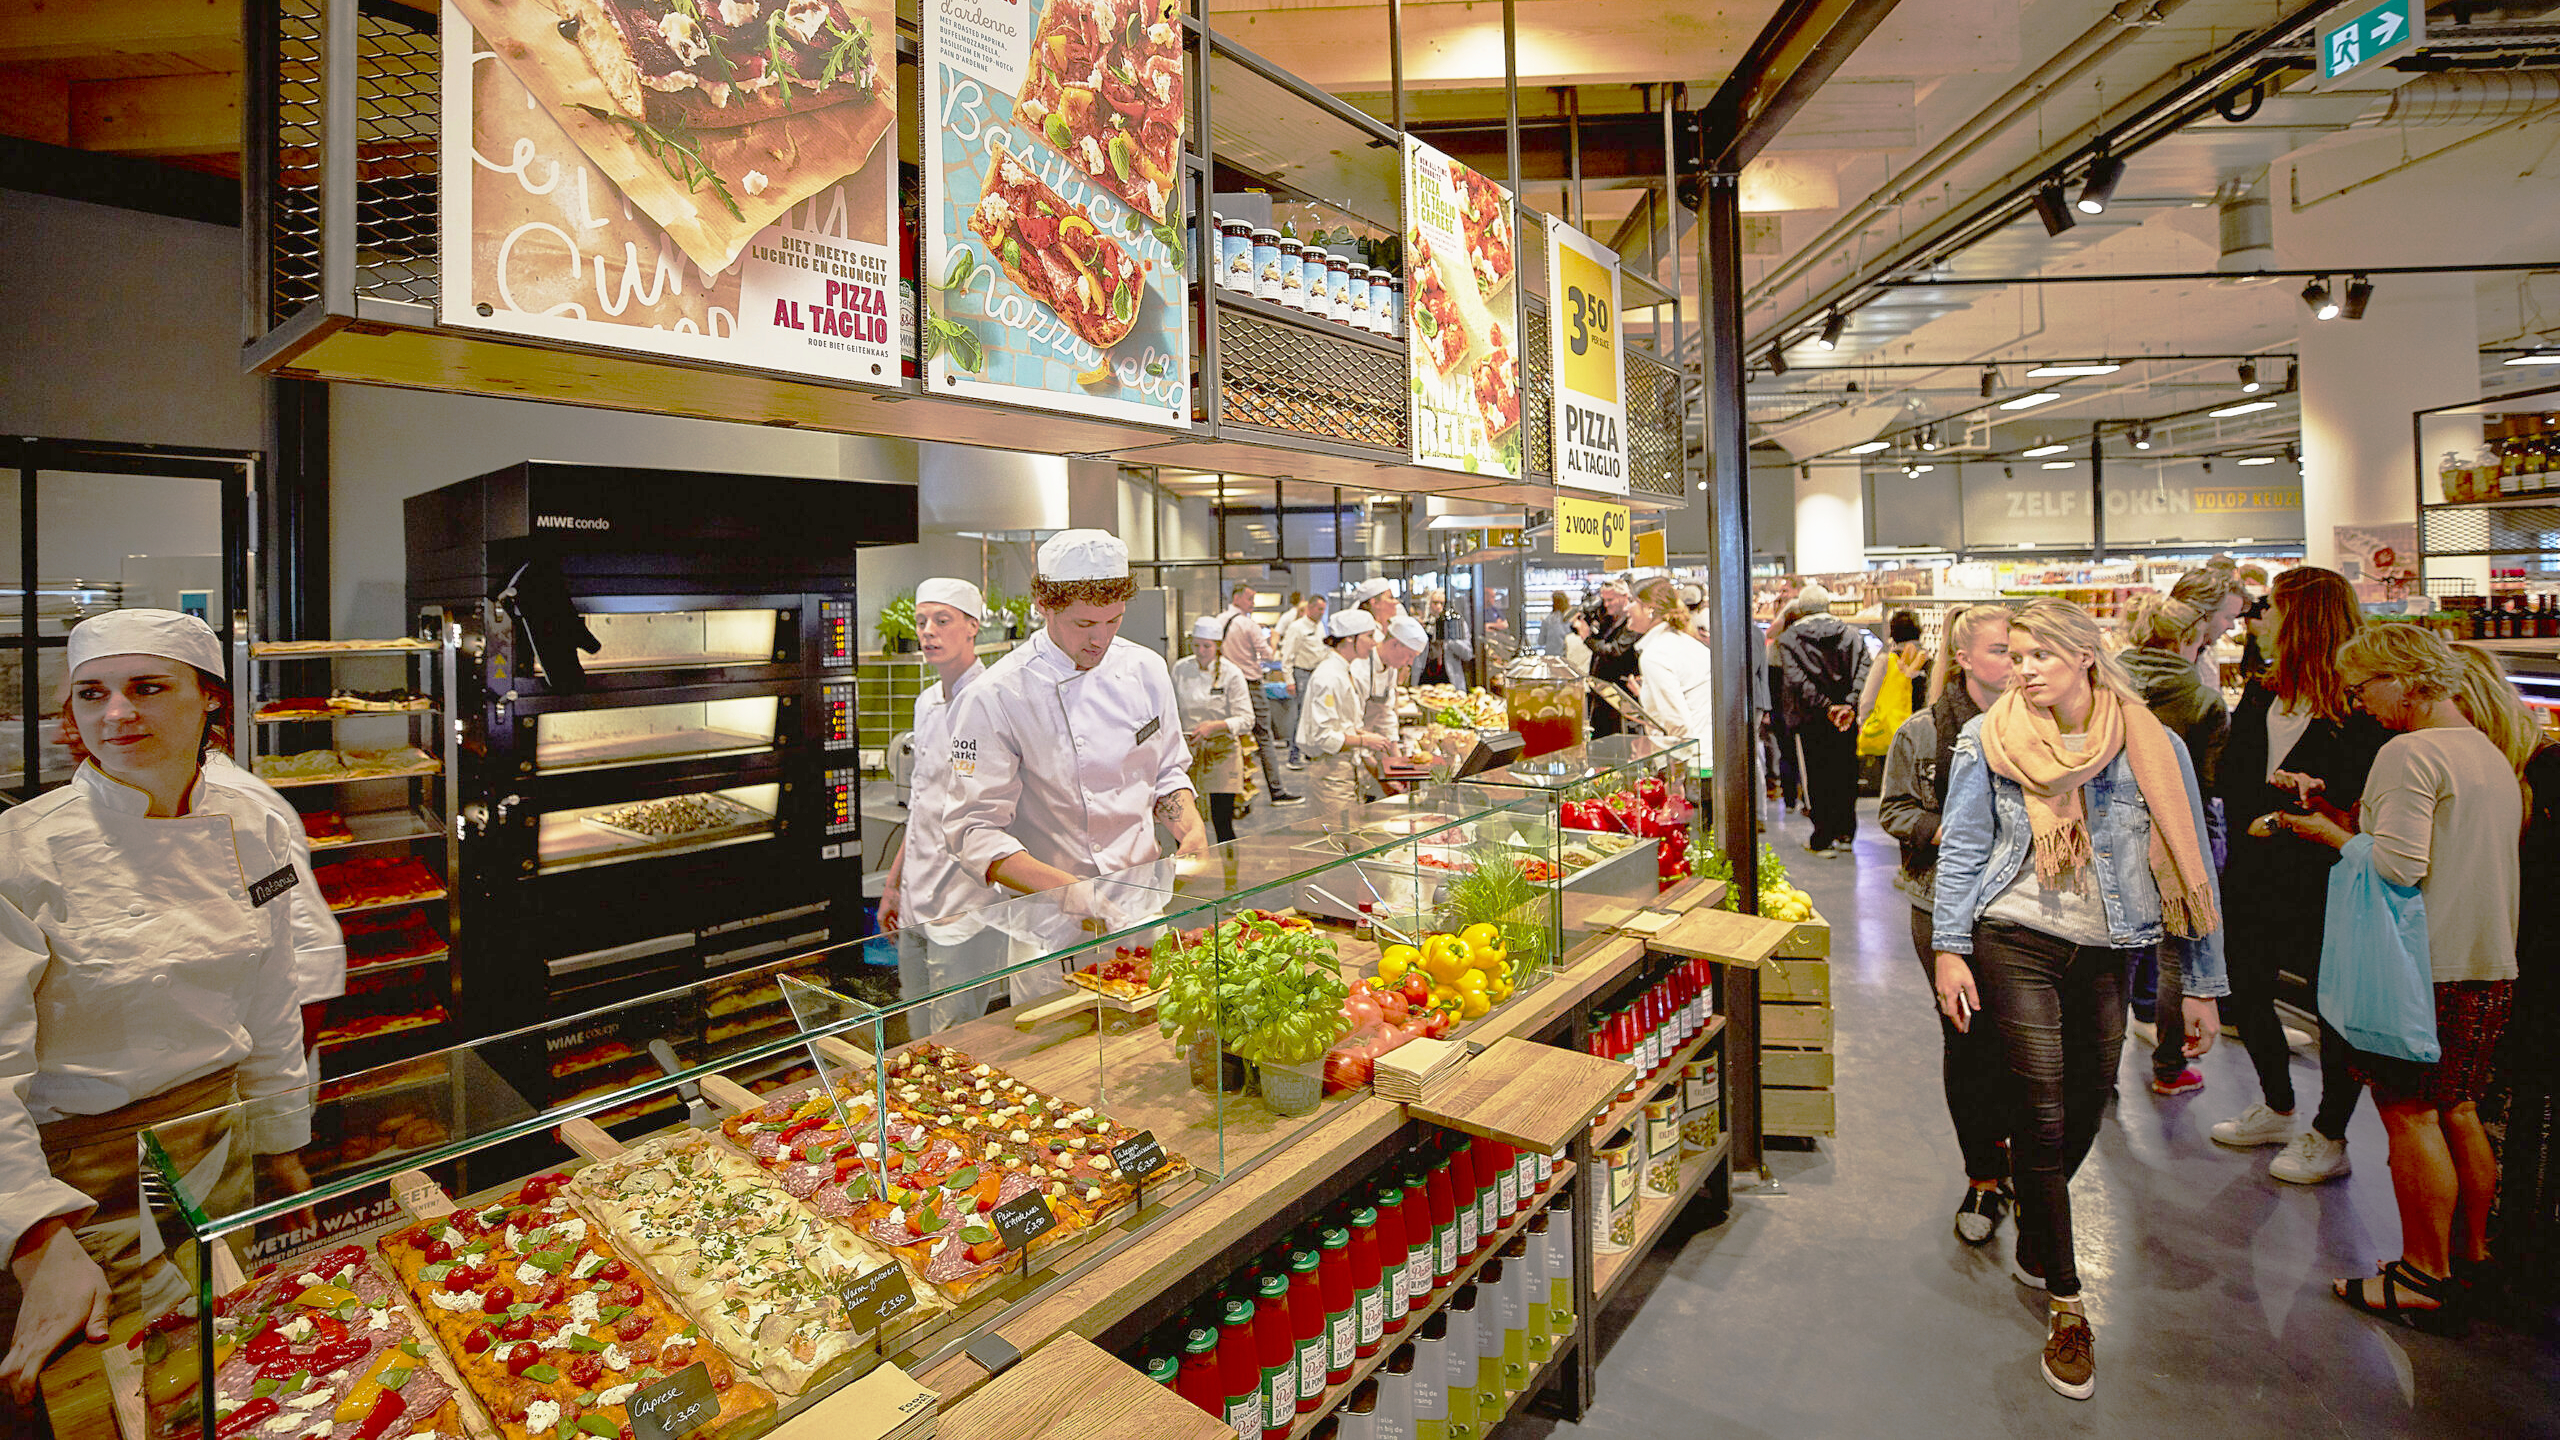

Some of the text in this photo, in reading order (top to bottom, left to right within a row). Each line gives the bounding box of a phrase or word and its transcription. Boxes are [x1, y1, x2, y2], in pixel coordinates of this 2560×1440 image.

[940, 15, 1008, 51] MET ROASTED PAPRIKA,
[940, 47, 955, 59] PAIN
[940, 36, 1014, 73] BASILICUM EN TOP-NOTCH
[1420, 173, 1441, 198] PIZZA
[1420, 190, 1456, 220] AL TAGLIO
[1421, 206, 1454, 235] CAPRESE
[752, 244, 887, 287] LUCHTIG EN CRUNCHY
[781, 235, 887, 273] BIET MEETS GEIT
[825, 278, 888, 318] PIZZA
[773, 298, 805, 331] AL
[808, 304, 888, 345] TAGLIO
[808, 337, 889, 359] RODE BIET GEITENKAAS
[1565, 403, 1620, 454] PIZZA
[1567, 447, 1621, 479] AL TAGLIO
[2006, 490, 2076, 518] ZELF
[2194, 491, 2247, 509] VOLOP
[536, 515, 610, 531] MIWE condo
[1565, 515, 1572, 533] 2
[1573, 516, 1599, 536] VOOR
[242, 1221, 318, 1260] WETEN
[322, 1205, 368, 1233] WAT
[370, 1197, 395, 1217] JE
[634, 1386, 684, 1418] Caprese
